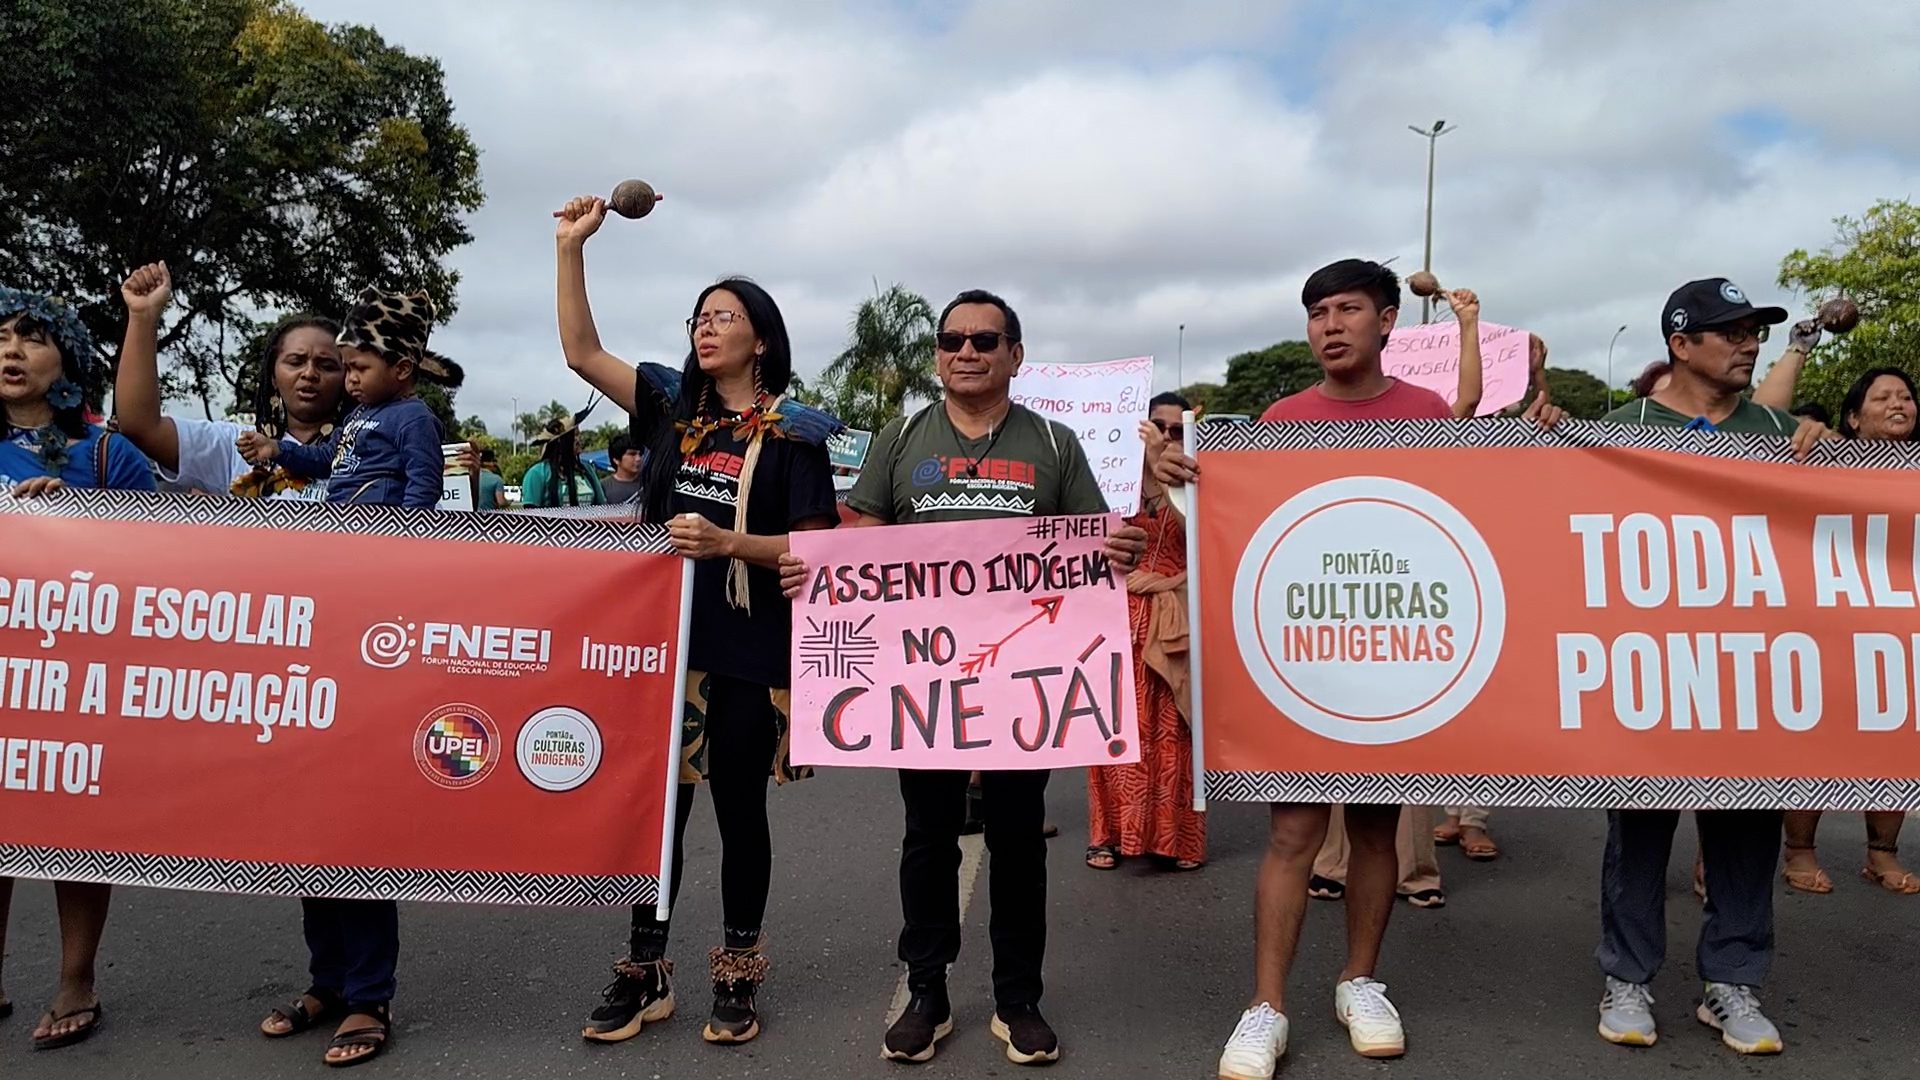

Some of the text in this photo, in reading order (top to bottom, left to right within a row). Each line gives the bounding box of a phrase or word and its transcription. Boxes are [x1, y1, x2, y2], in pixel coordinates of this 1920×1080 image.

[1010, 394, 1074, 413] eremos
[1082, 401, 1112, 414] uma
[1101, 456, 1127, 470] ser
[1027, 516, 1107, 541] #FNEEI
[808, 541, 1117, 606] ASSENTO INDÍGENA
[1322, 549, 1410, 575] PONTÃO DE
[1570, 512, 1920, 608] TODA AL
[131, 586, 315, 648] ESCOLAR
[1286, 581, 1449, 620] CULTURAS
[421, 622, 551, 663] FNEEI
[902, 626, 956, 666] NO
[1283, 617, 1456, 662] INDÍGENAS
[447, 665, 482, 675] ESCOLAR
[450, 658, 490, 668] NACIONAL
[504, 662, 548, 673] EDUCAÇÃO
[1556, 631, 1920, 732] PONTO D
[0, 656, 338, 744] TIR A EDUCAÇÃO
[1011, 634, 1128, 758] JÁ!
[429, 735, 483, 756] UPEI
[531, 751, 586, 767] INDÍGENAS
[533, 739, 585, 754] CULTURAS
[0, 737, 104, 796] EITO!
